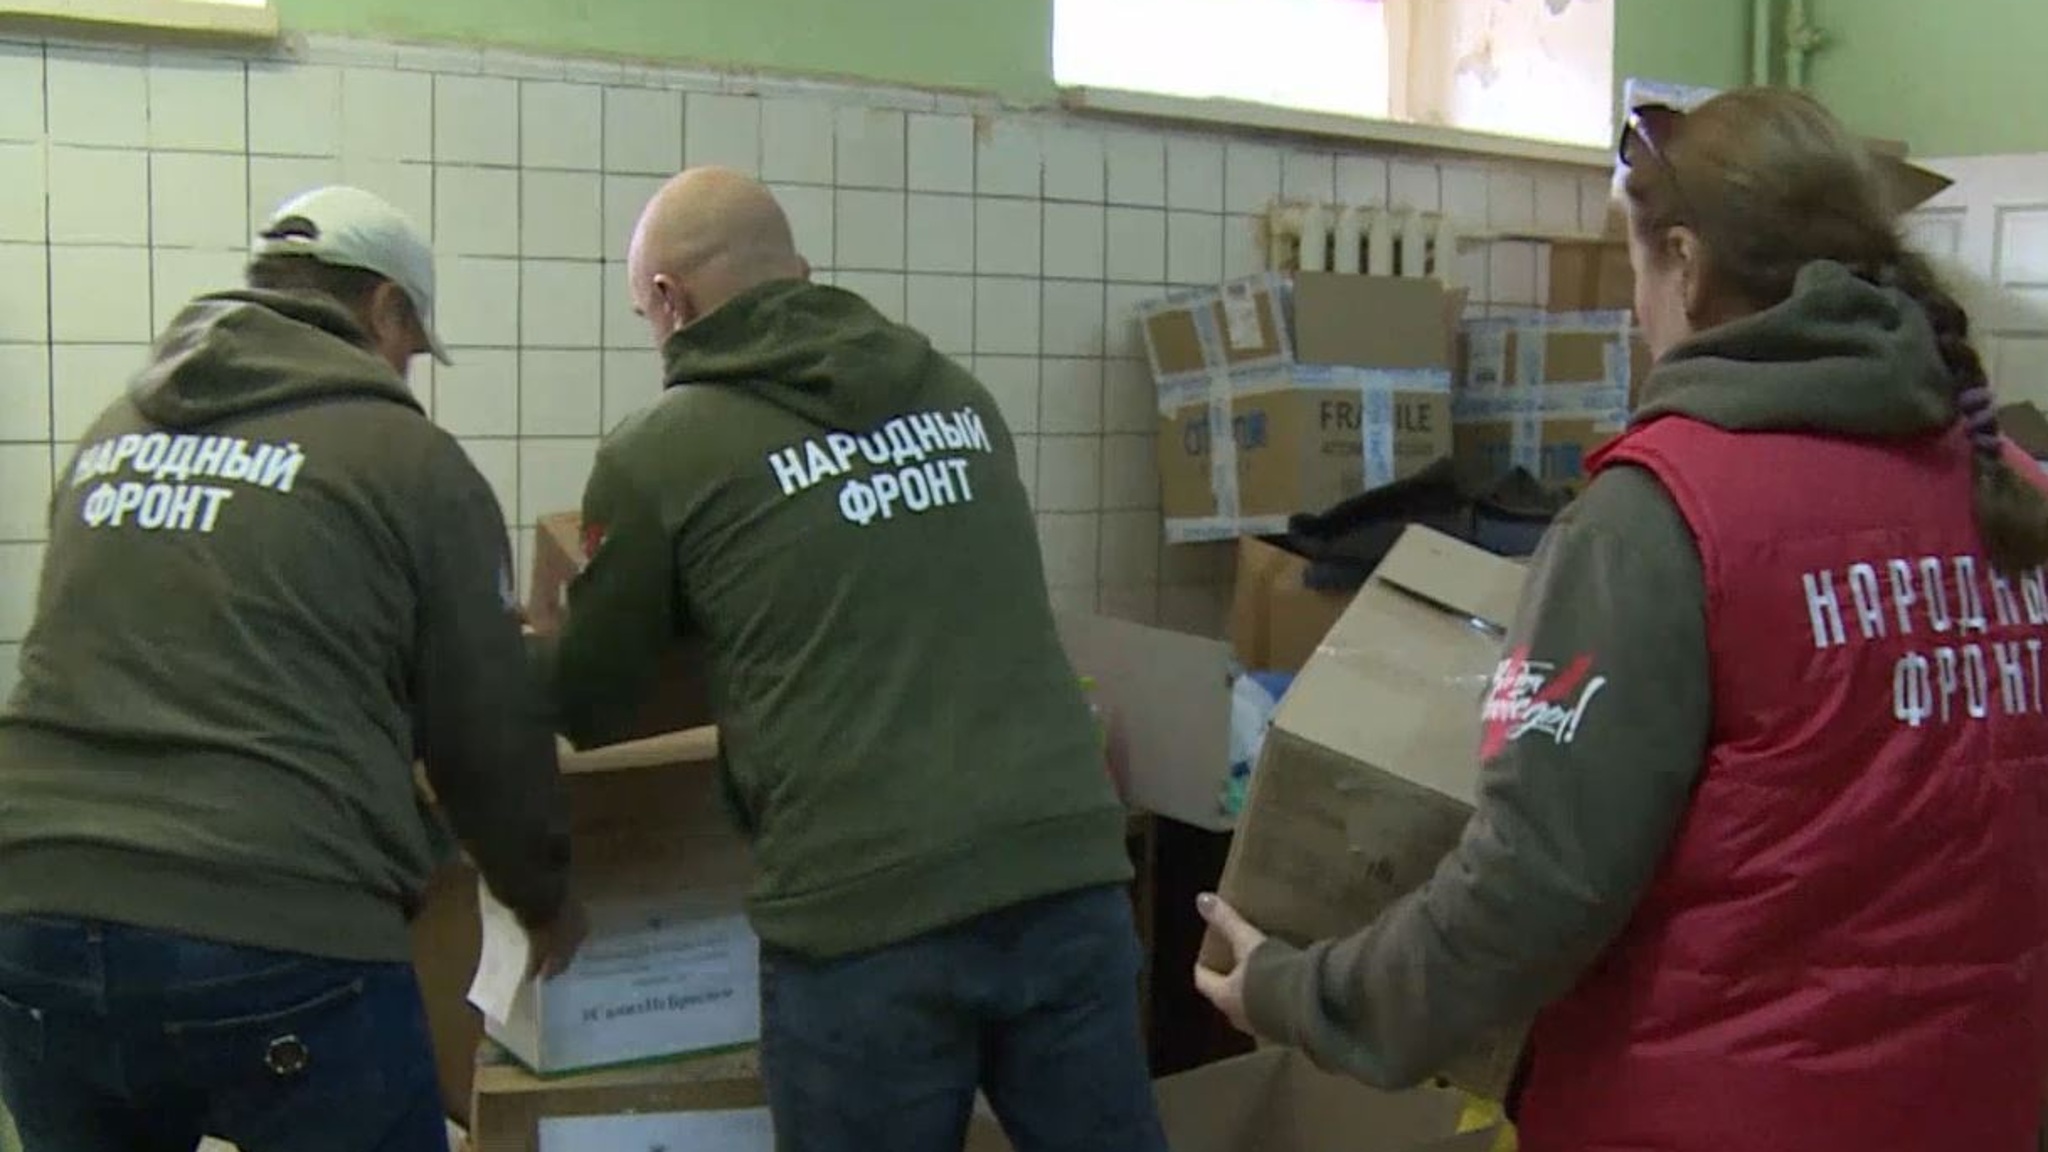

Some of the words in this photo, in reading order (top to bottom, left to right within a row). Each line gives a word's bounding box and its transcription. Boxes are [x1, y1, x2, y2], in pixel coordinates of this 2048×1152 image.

[768, 406, 992, 496] НАРОДНЫЙ
[1320, 399, 1431, 432] FRAILE
[83, 482, 234, 532] ФРОНТ
[838, 458, 972, 526] ФРОНТ
[1802, 555, 2048, 649] НАРОДНЫ
[1893, 639, 2043, 727] ФРОНТ
